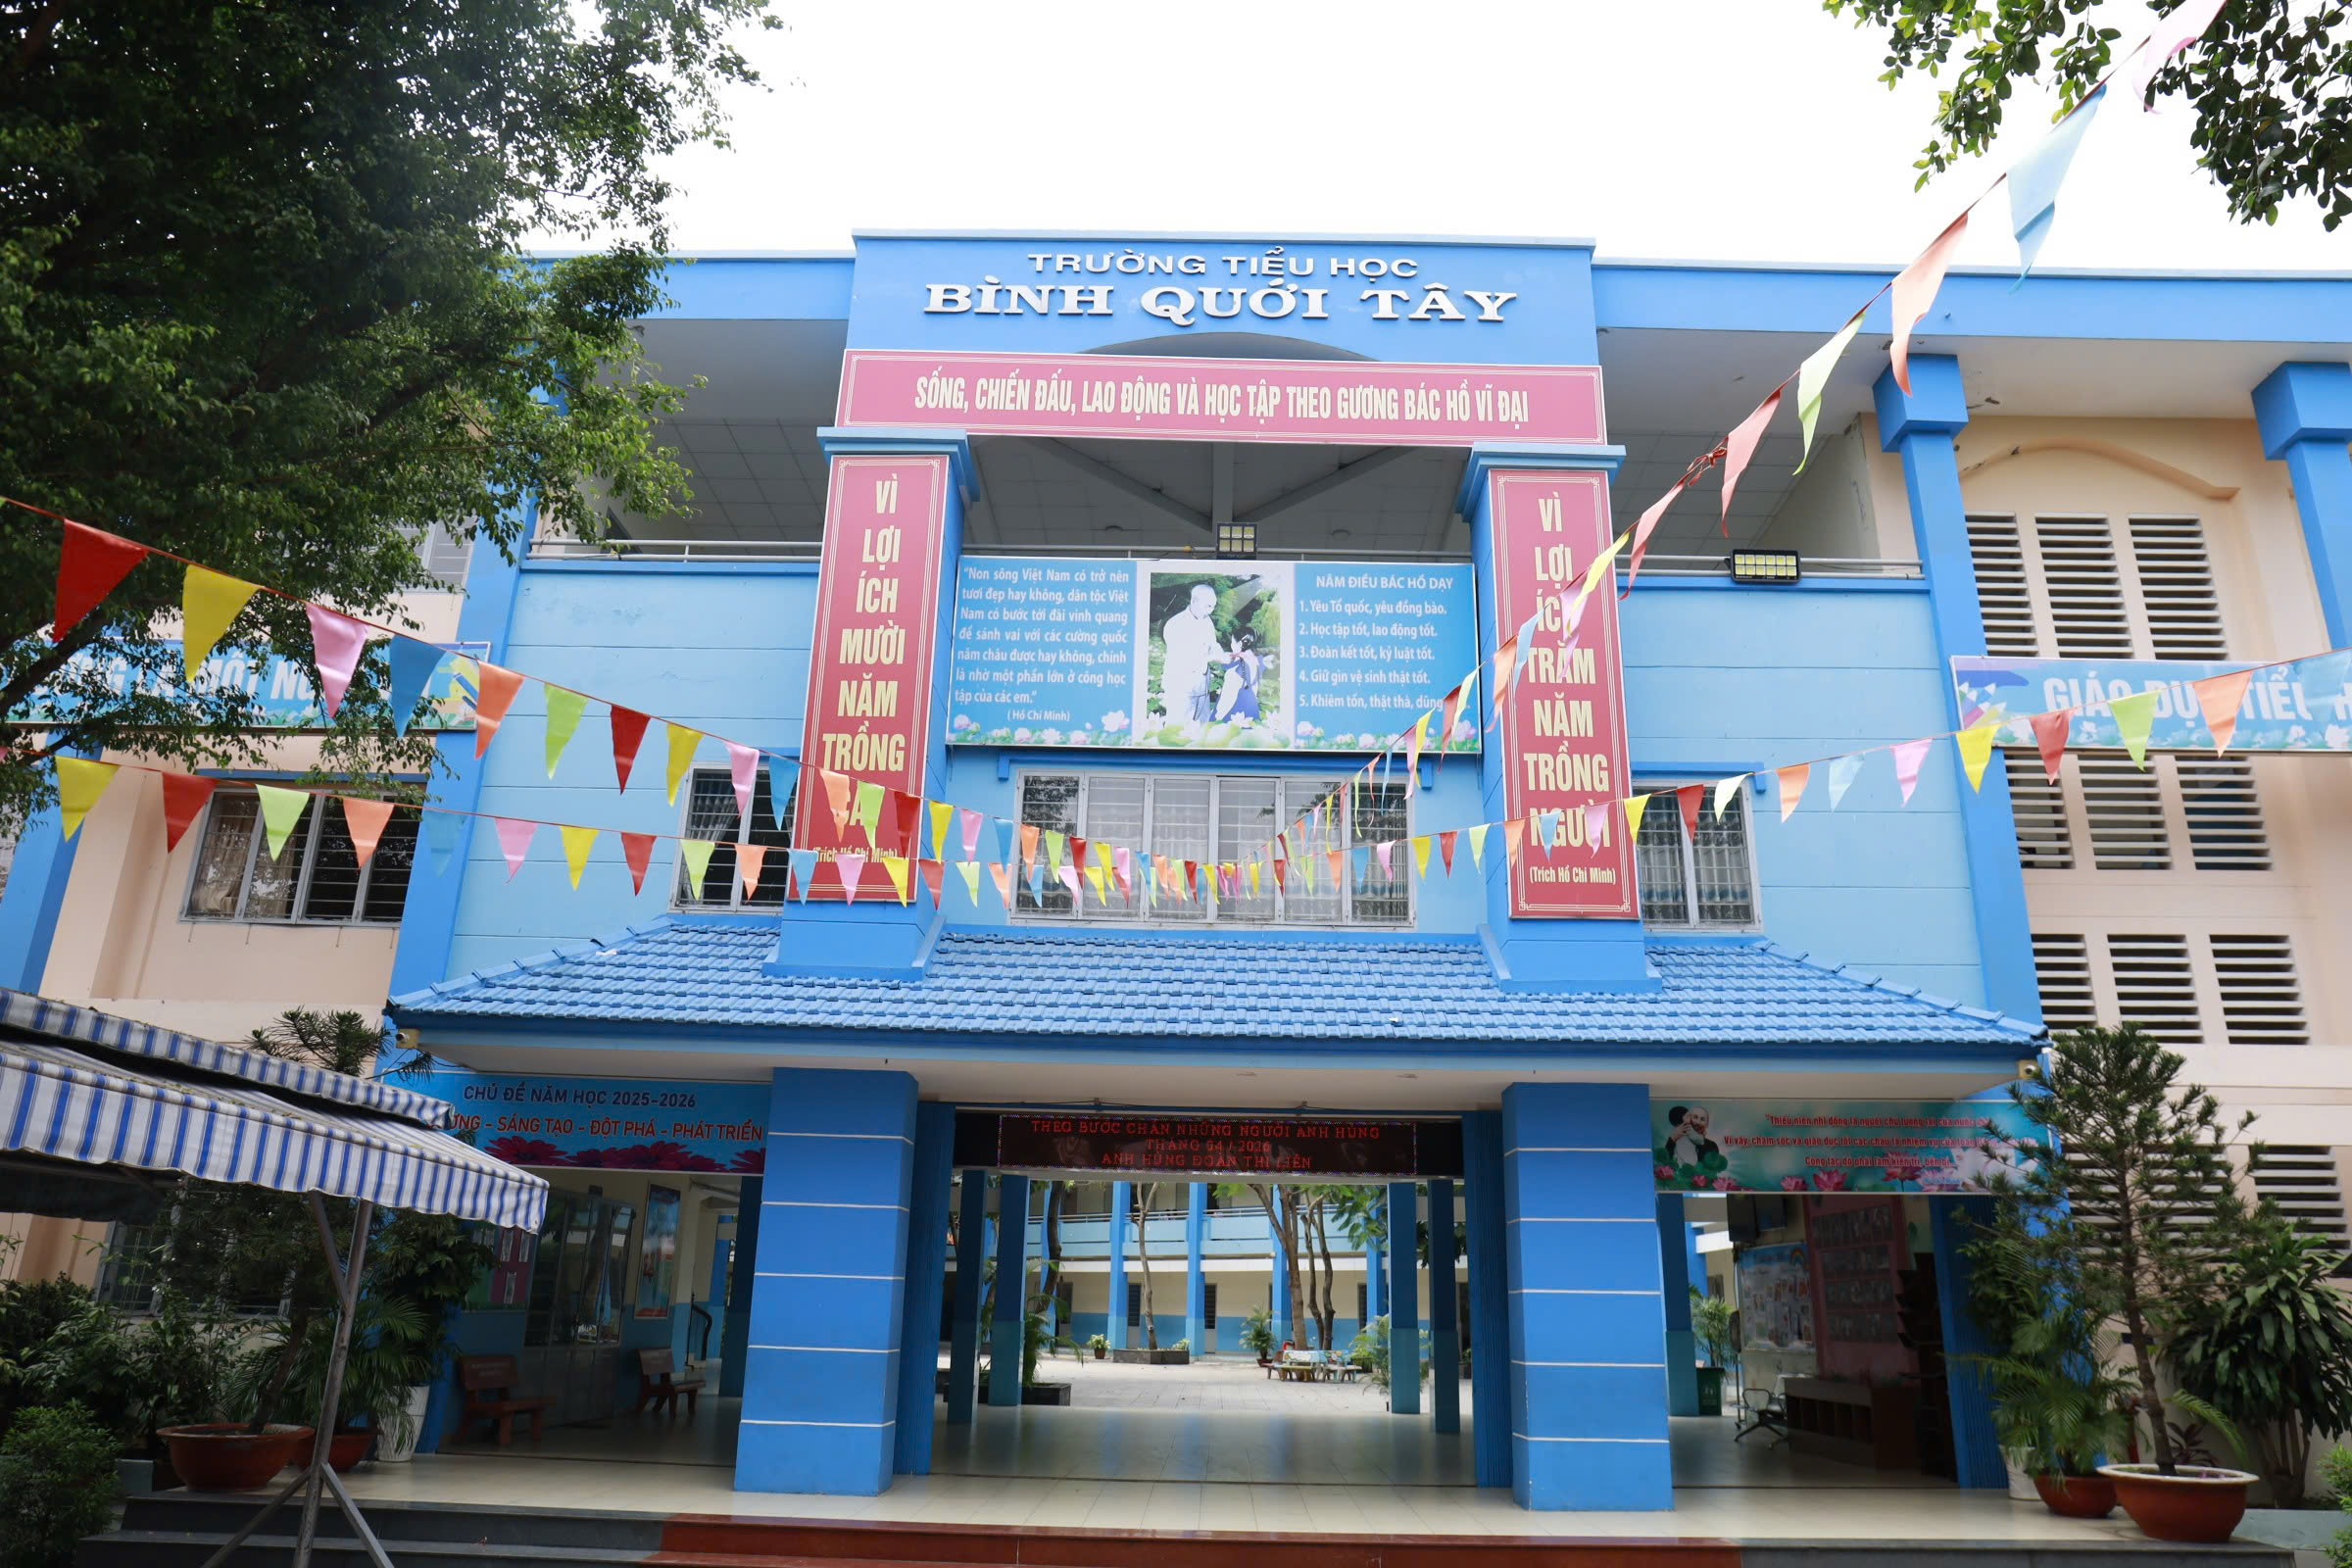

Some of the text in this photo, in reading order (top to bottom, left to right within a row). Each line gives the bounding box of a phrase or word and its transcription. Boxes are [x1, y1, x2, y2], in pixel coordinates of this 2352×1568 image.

[1027, 246, 1418, 282] TRƯỜNG TIỂU HỌC
[924, 275, 1517, 326] BÌNH QUỚI TÂY
[914, 366, 1529, 429] SỐNG, CHIẾN ĐẤU, LAO ĐỘNG VÀ HỌC TẬP THEO GƯƠNG BÁC HỒ VĨ ĐẠI
[876, 473, 898, 514] VÌ
[1538, 491, 1563, 532] VÌ
[862, 525, 901, 570] LỢI
[1535, 544, 1573, 589] LỢI
[856, 571, 899, 612] ÍCH
[994, 569, 1018, 583] sông
[1022, 568, 1043, 584] Việt
[1047, 570, 1070, 581] Nam
[1074, 570, 1086, 582] có
[1109, 570, 1129, 582] nên
[1316, 573, 1453, 592] NĂM ĐIỀU BÁC HỒ DẠY
[960, 608, 1128, 625] Nam có bước tới đài vinh quang
[962, 588, 983, 599] tươi
[985, 588, 1004, 604] đẹp
[1007, 589, 1027, 603] hay
[1067, 589, 1087, 602] dân
[1090, 590, 1106, 605] tộc
[1109, 590, 1129, 606] Việt
[1299, 601, 1308, 612] 1.
[1310, 600, 1328, 612] Yêu
[1375, 601, 1394, 615] yêu
[1396, 601, 1422, 616] đồng
[1424, 602, 1446, 614] bào.
[1536, 589, 1572, 632] ÍC
[839, 620, 906, 664] MƯỜI
[1299, 623, 1308, 635] 2.
[1310, 623, 1330, 639] Học
[1333, 622, 1349, 639] tập
[1372, 624, 1388, 635] lao
[1391, 622, 1417, 639] động
[1419, 622, 1438, 637] tốt.
[1299, 646, 1308, 658] 3.
[1310, 646, 1339, 659] Đoàn
[1341, 645, 1357, 659] kết
[1395, 646, 1415, 662] luật
[1416, 646, 1435, 660] tốt.
[1528, 640, 1596, 684] TRĂM
[838, 672, 898, 716] NĂM
[1299, 671, 1308, 682] 4.
[1310, 669, 1330, 683] Giữ
[1350, 671, 1363, 686] vệ
[1364, 670, 1387, 683] sinh
[1389, 671, 1410, 686] thật
[1412, 670, 1431, 683] tốt.
[1299, 695, 1308, 707] 5.
[1310, 694, 1345, 707] Khiêm
[1369, 695, 1392, 710] thật
[1533, 692, 1593, 737] NĂM
[2143, 679, 2213, 727] DỤ
[822, 720, 906, 771] TRỒNG
[1523, 741, 1609, 792] TRỒNG
[464, 1082, 697, 1108] CHỦ ĐỀ NĂM HỌC 2025-2026
[497, 1113, 762, 1142] SÁNG TẠO ĐỘT PHÁ PHÁT TRIỂN
[1031, 1120, 1073, 1133] THEO
[1297, 1126, 1329, 1139] ANH
[1102, 1152, 1135, 1164] ANH
